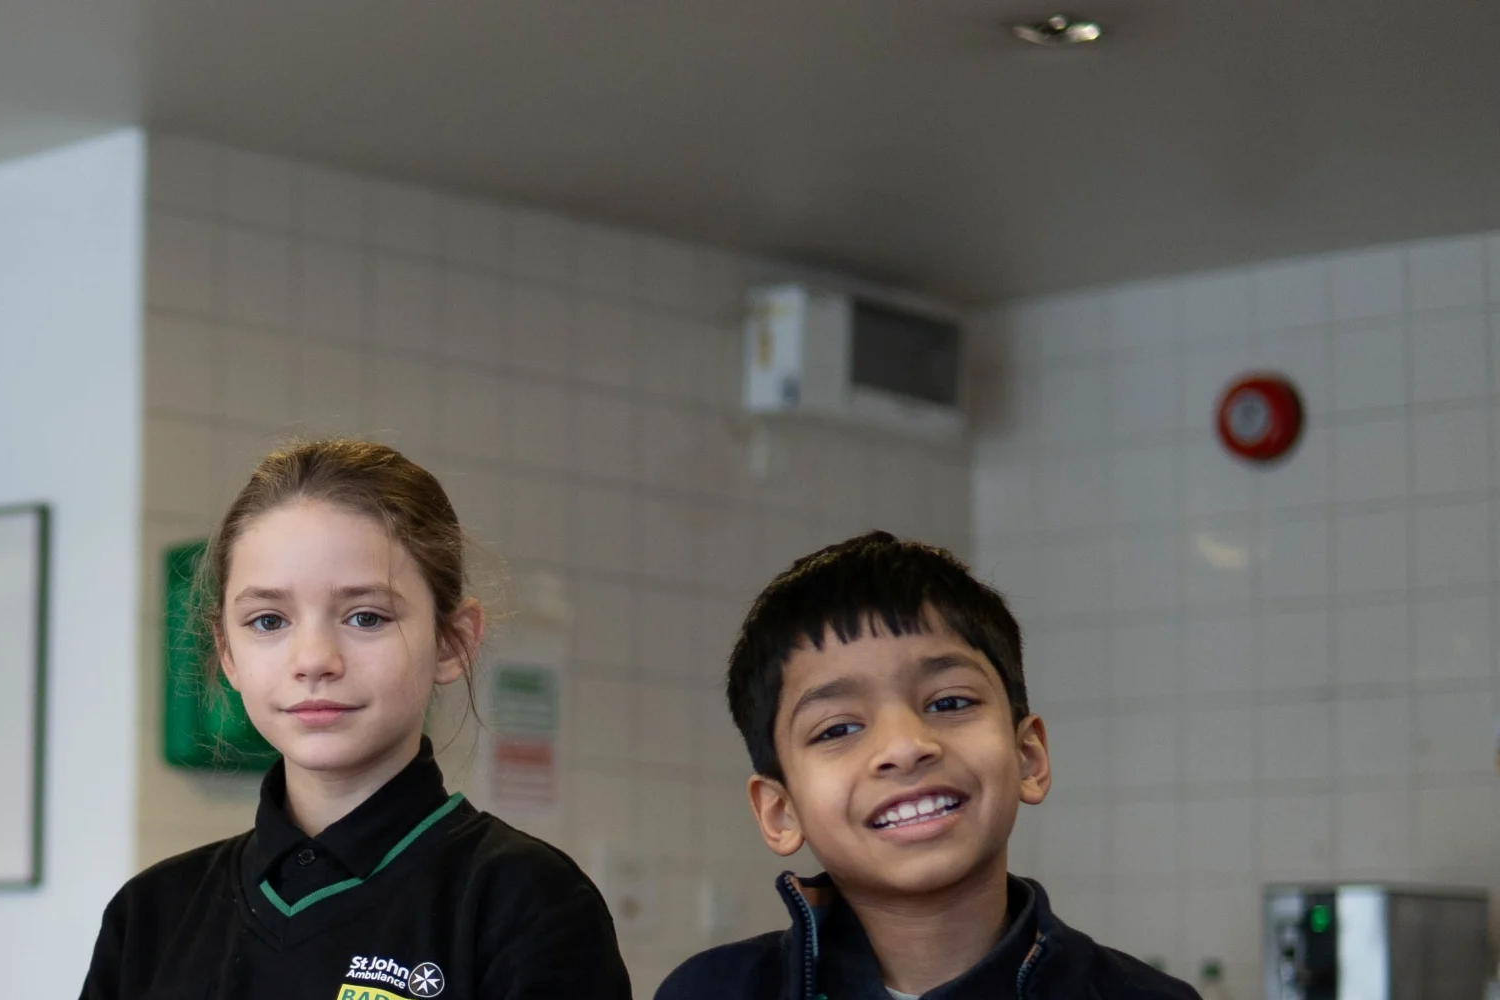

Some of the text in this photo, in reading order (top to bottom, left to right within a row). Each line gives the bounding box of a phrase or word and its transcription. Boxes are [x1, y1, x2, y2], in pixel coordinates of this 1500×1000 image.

[346, 969, 406, 989] Ambulance
[350, 956, 409, 980] St John
